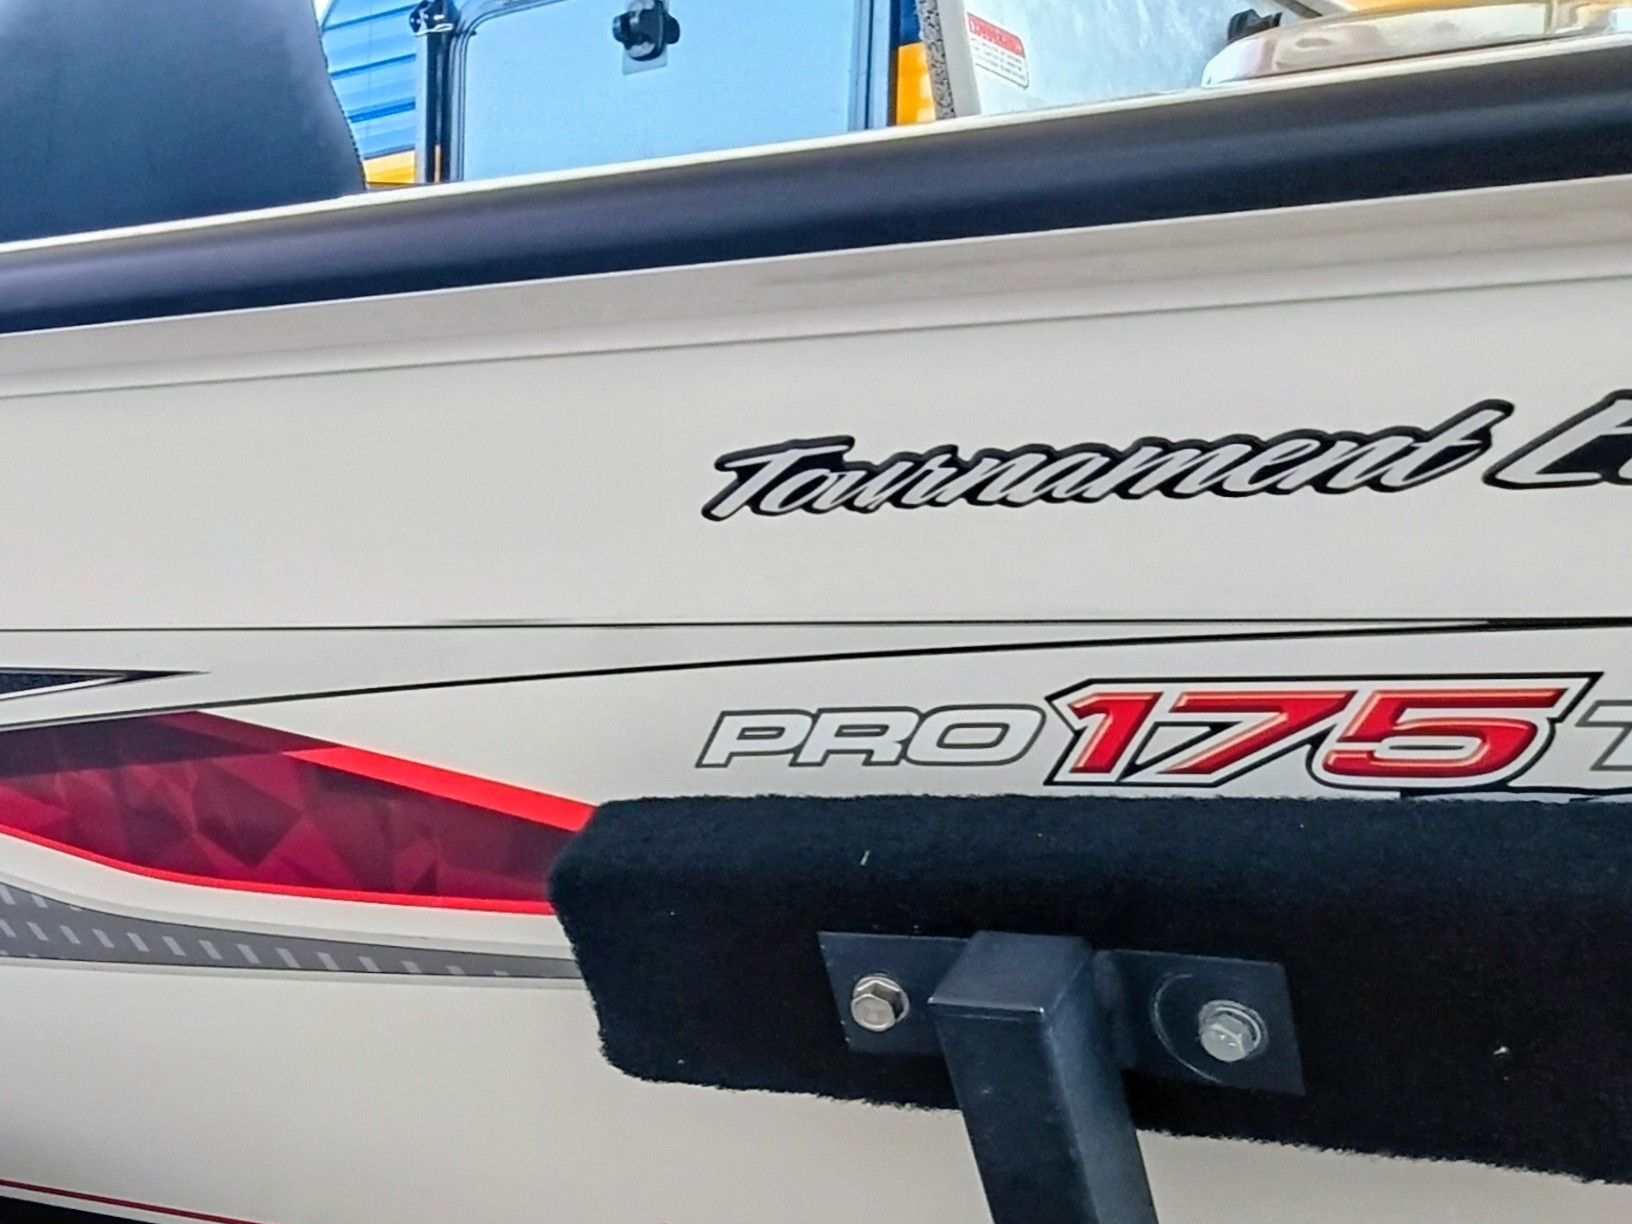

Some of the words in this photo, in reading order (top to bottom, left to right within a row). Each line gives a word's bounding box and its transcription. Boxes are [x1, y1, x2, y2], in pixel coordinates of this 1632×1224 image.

[701, 399, 1515, 521] Tournament
[695, 704, 1047, 769] PRO
[1044, 672, 1604, 788] 175
